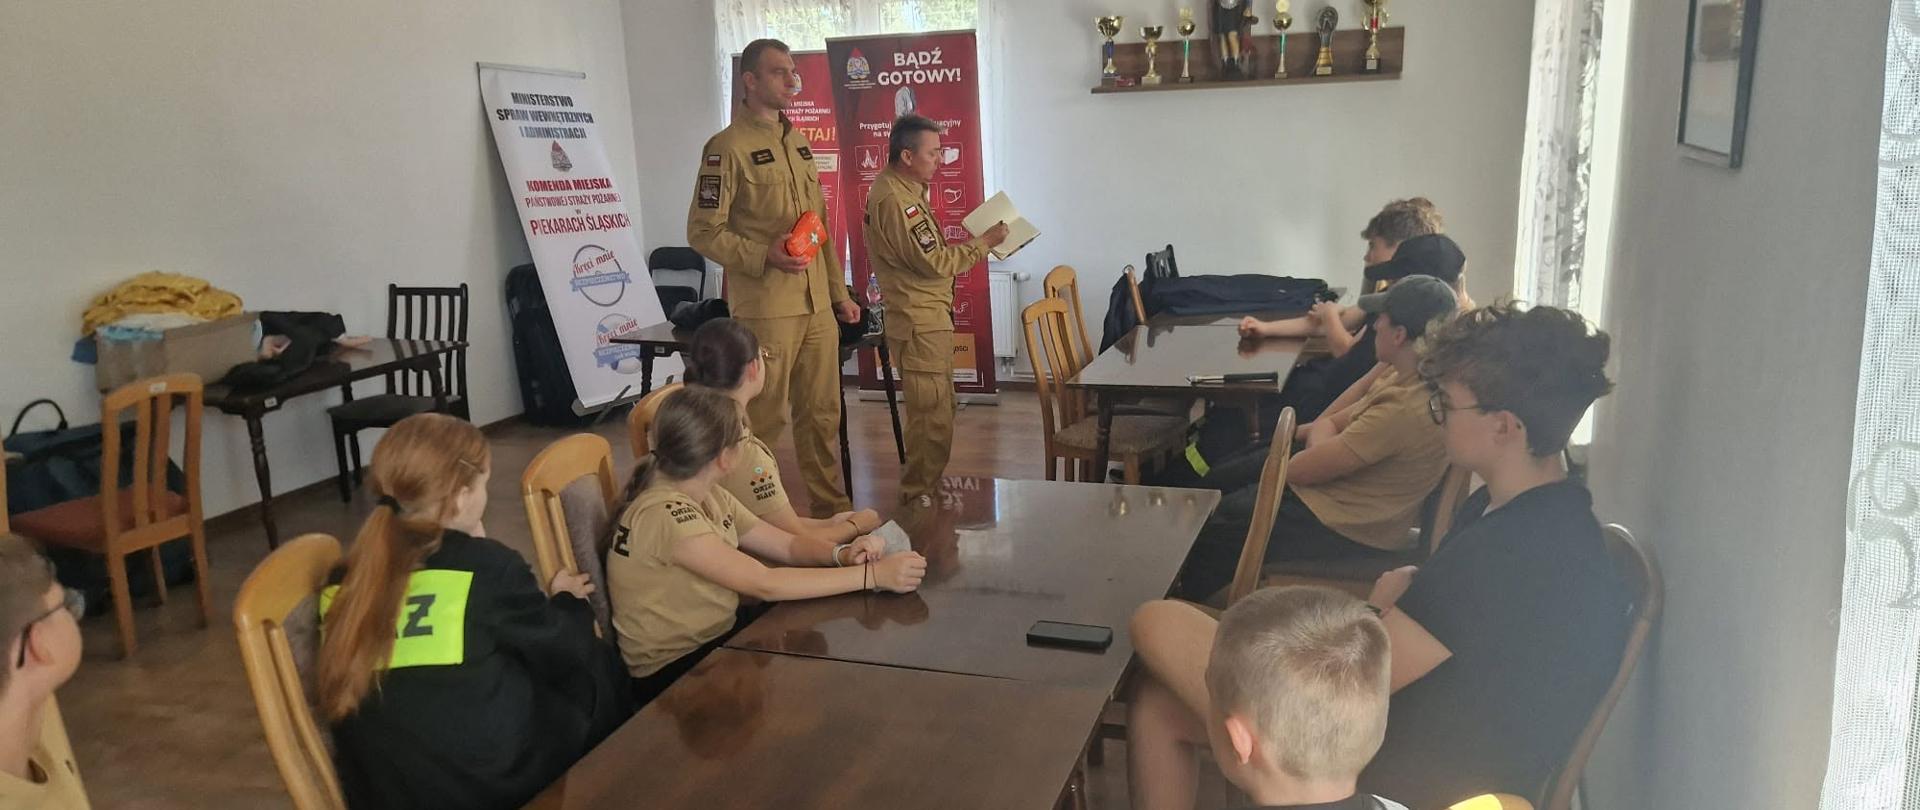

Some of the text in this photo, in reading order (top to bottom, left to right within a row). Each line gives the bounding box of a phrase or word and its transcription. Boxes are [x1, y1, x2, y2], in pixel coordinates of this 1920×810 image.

[894, 47, 942, 69] BĄDŹ
[877, 68, 961, 85] GOTOWY!
[511, 92, 573, 107] MINISTERSTWO
[496, 109, 594, 124] SPRAW WEWNĘTRZNYCH
[519, 126, 587, 139] I ADMINISTRACJI
[859, 121, 892, 131] Przygotuj
[526, 178, 612, 192] KOMENDA MIEJSKA
[525, 193, 621, 208] PAŃSTWOWEJ STRAŻY POŻARNEJ
[530, 213, 631, 235] PIEKARACH ŚLĄSKICH
[595, 250, 615, 265] mnie
